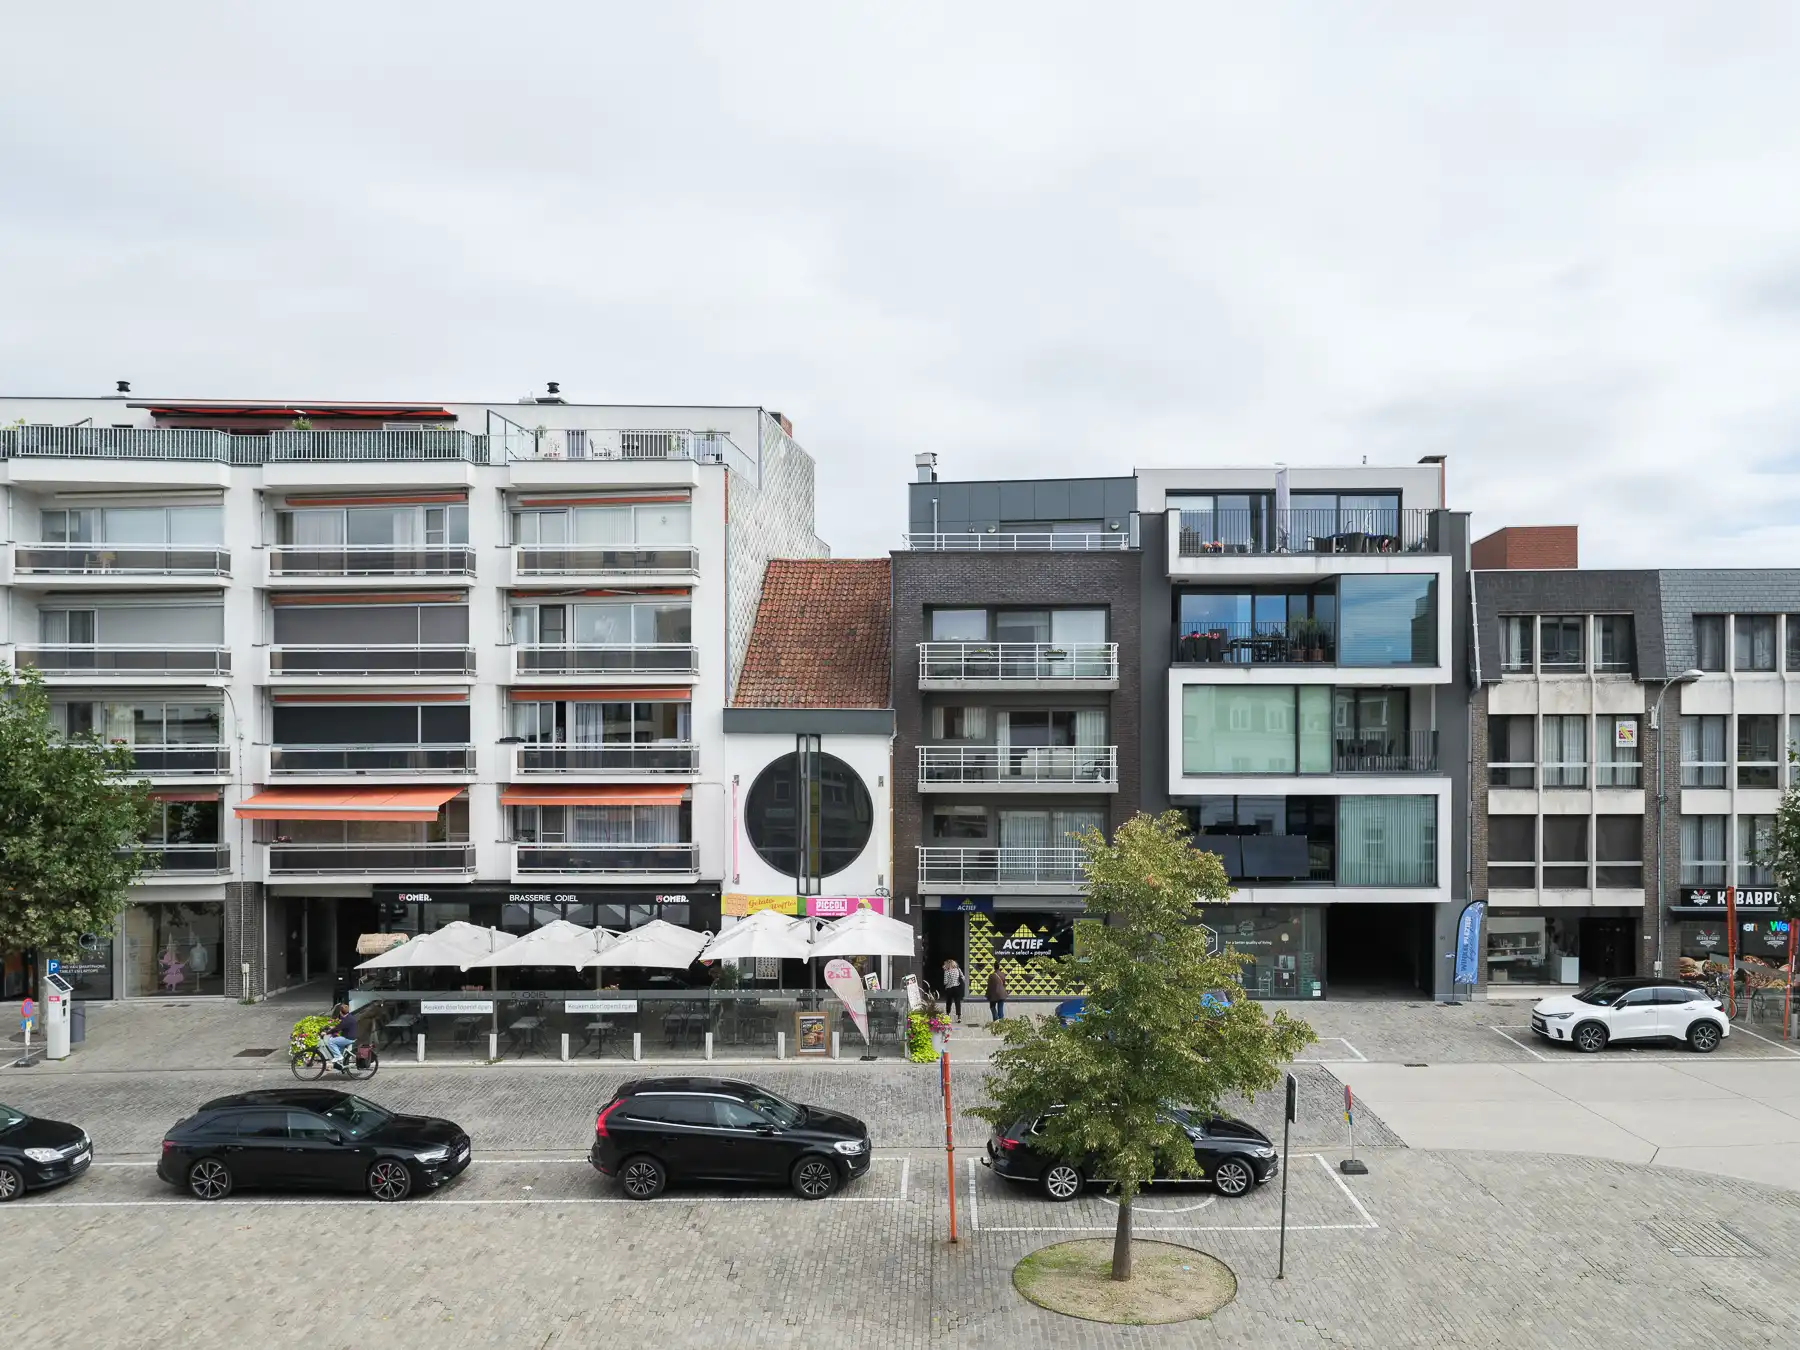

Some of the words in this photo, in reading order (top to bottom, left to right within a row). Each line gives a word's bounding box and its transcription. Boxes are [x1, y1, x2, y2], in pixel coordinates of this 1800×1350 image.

[509, 894, 551, 902] BRASSERIE
[554, 894, 578, 902] ODIEL
[815, 900, 847, 910] PICCOLI
[1002, 938, 1044, 950] ACTIEF
[50, 962, 58, 971] P
